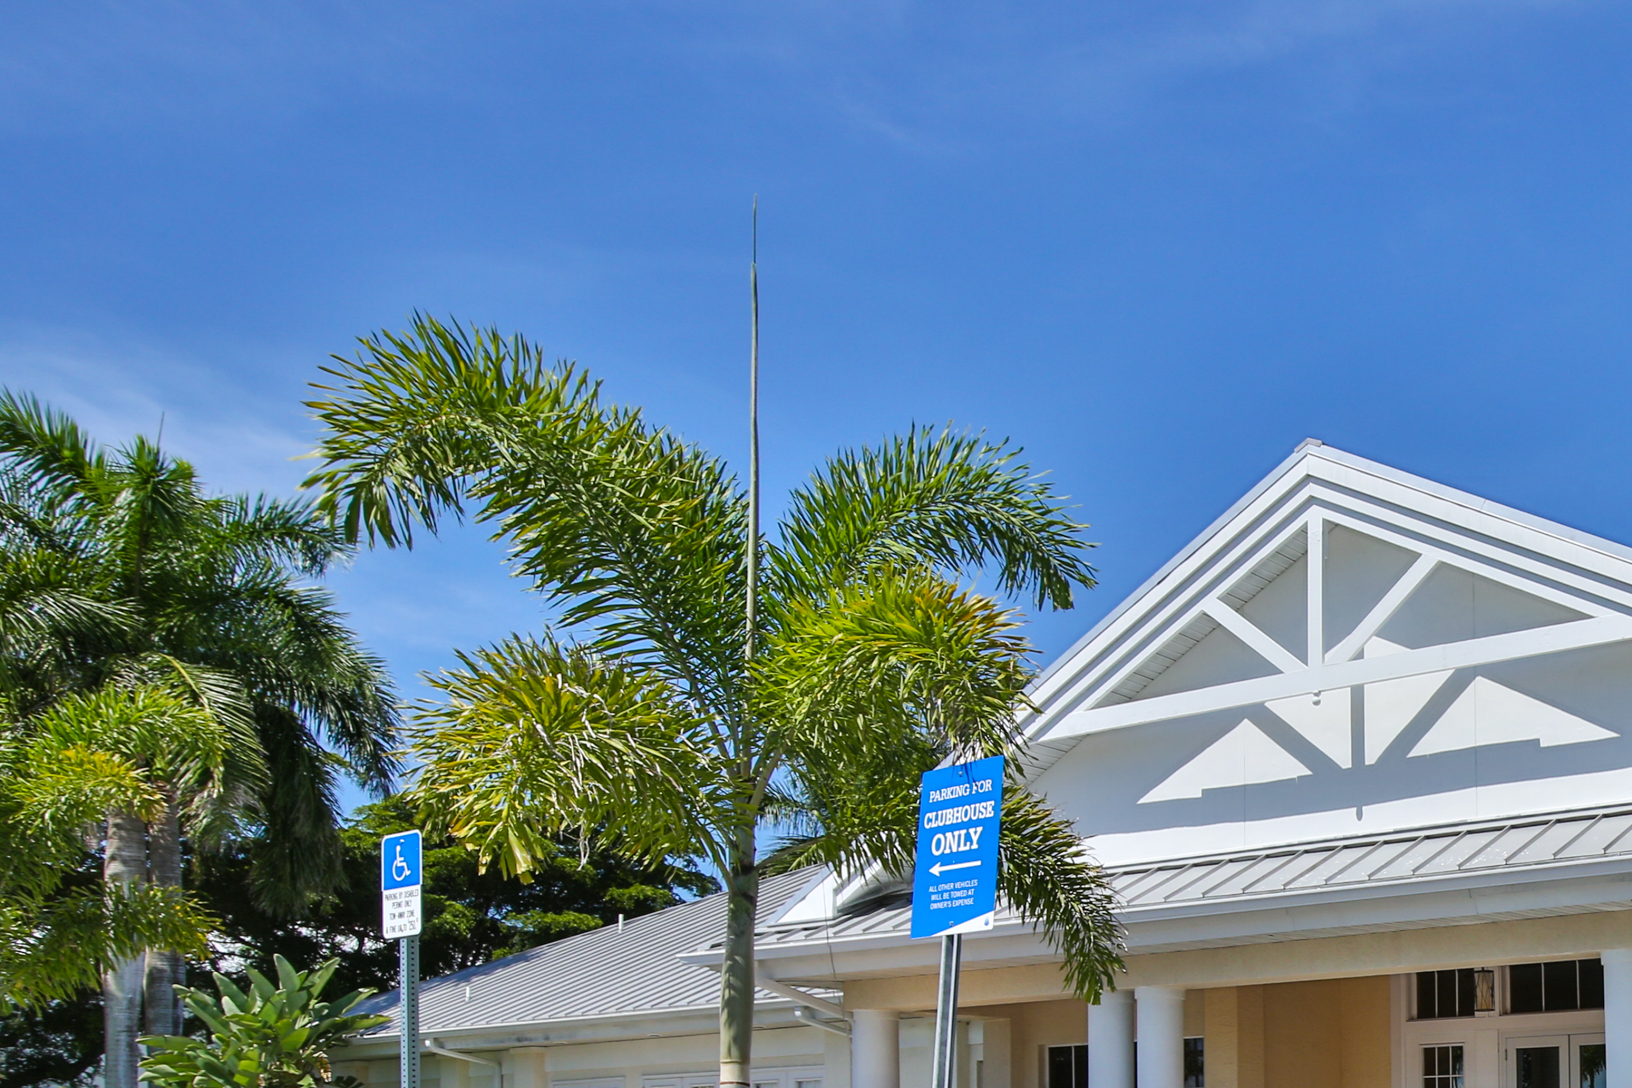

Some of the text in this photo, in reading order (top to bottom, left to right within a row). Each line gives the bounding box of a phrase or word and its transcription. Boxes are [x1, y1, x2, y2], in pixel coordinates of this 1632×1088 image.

[929, 779, 992, 803] PARKING FOR
[924, 800, 995, 829] CLUBHOUSE
[931, 826, 983, 856] ONLY
[938, 883, 954, 891] OTHER
[955, 879, 978, 888] VEHICLES
[931, 893, 942, 901] WILL
[951, 889, 967, 898] TOWED
[952, 897, 974, 907] EXPENSE
